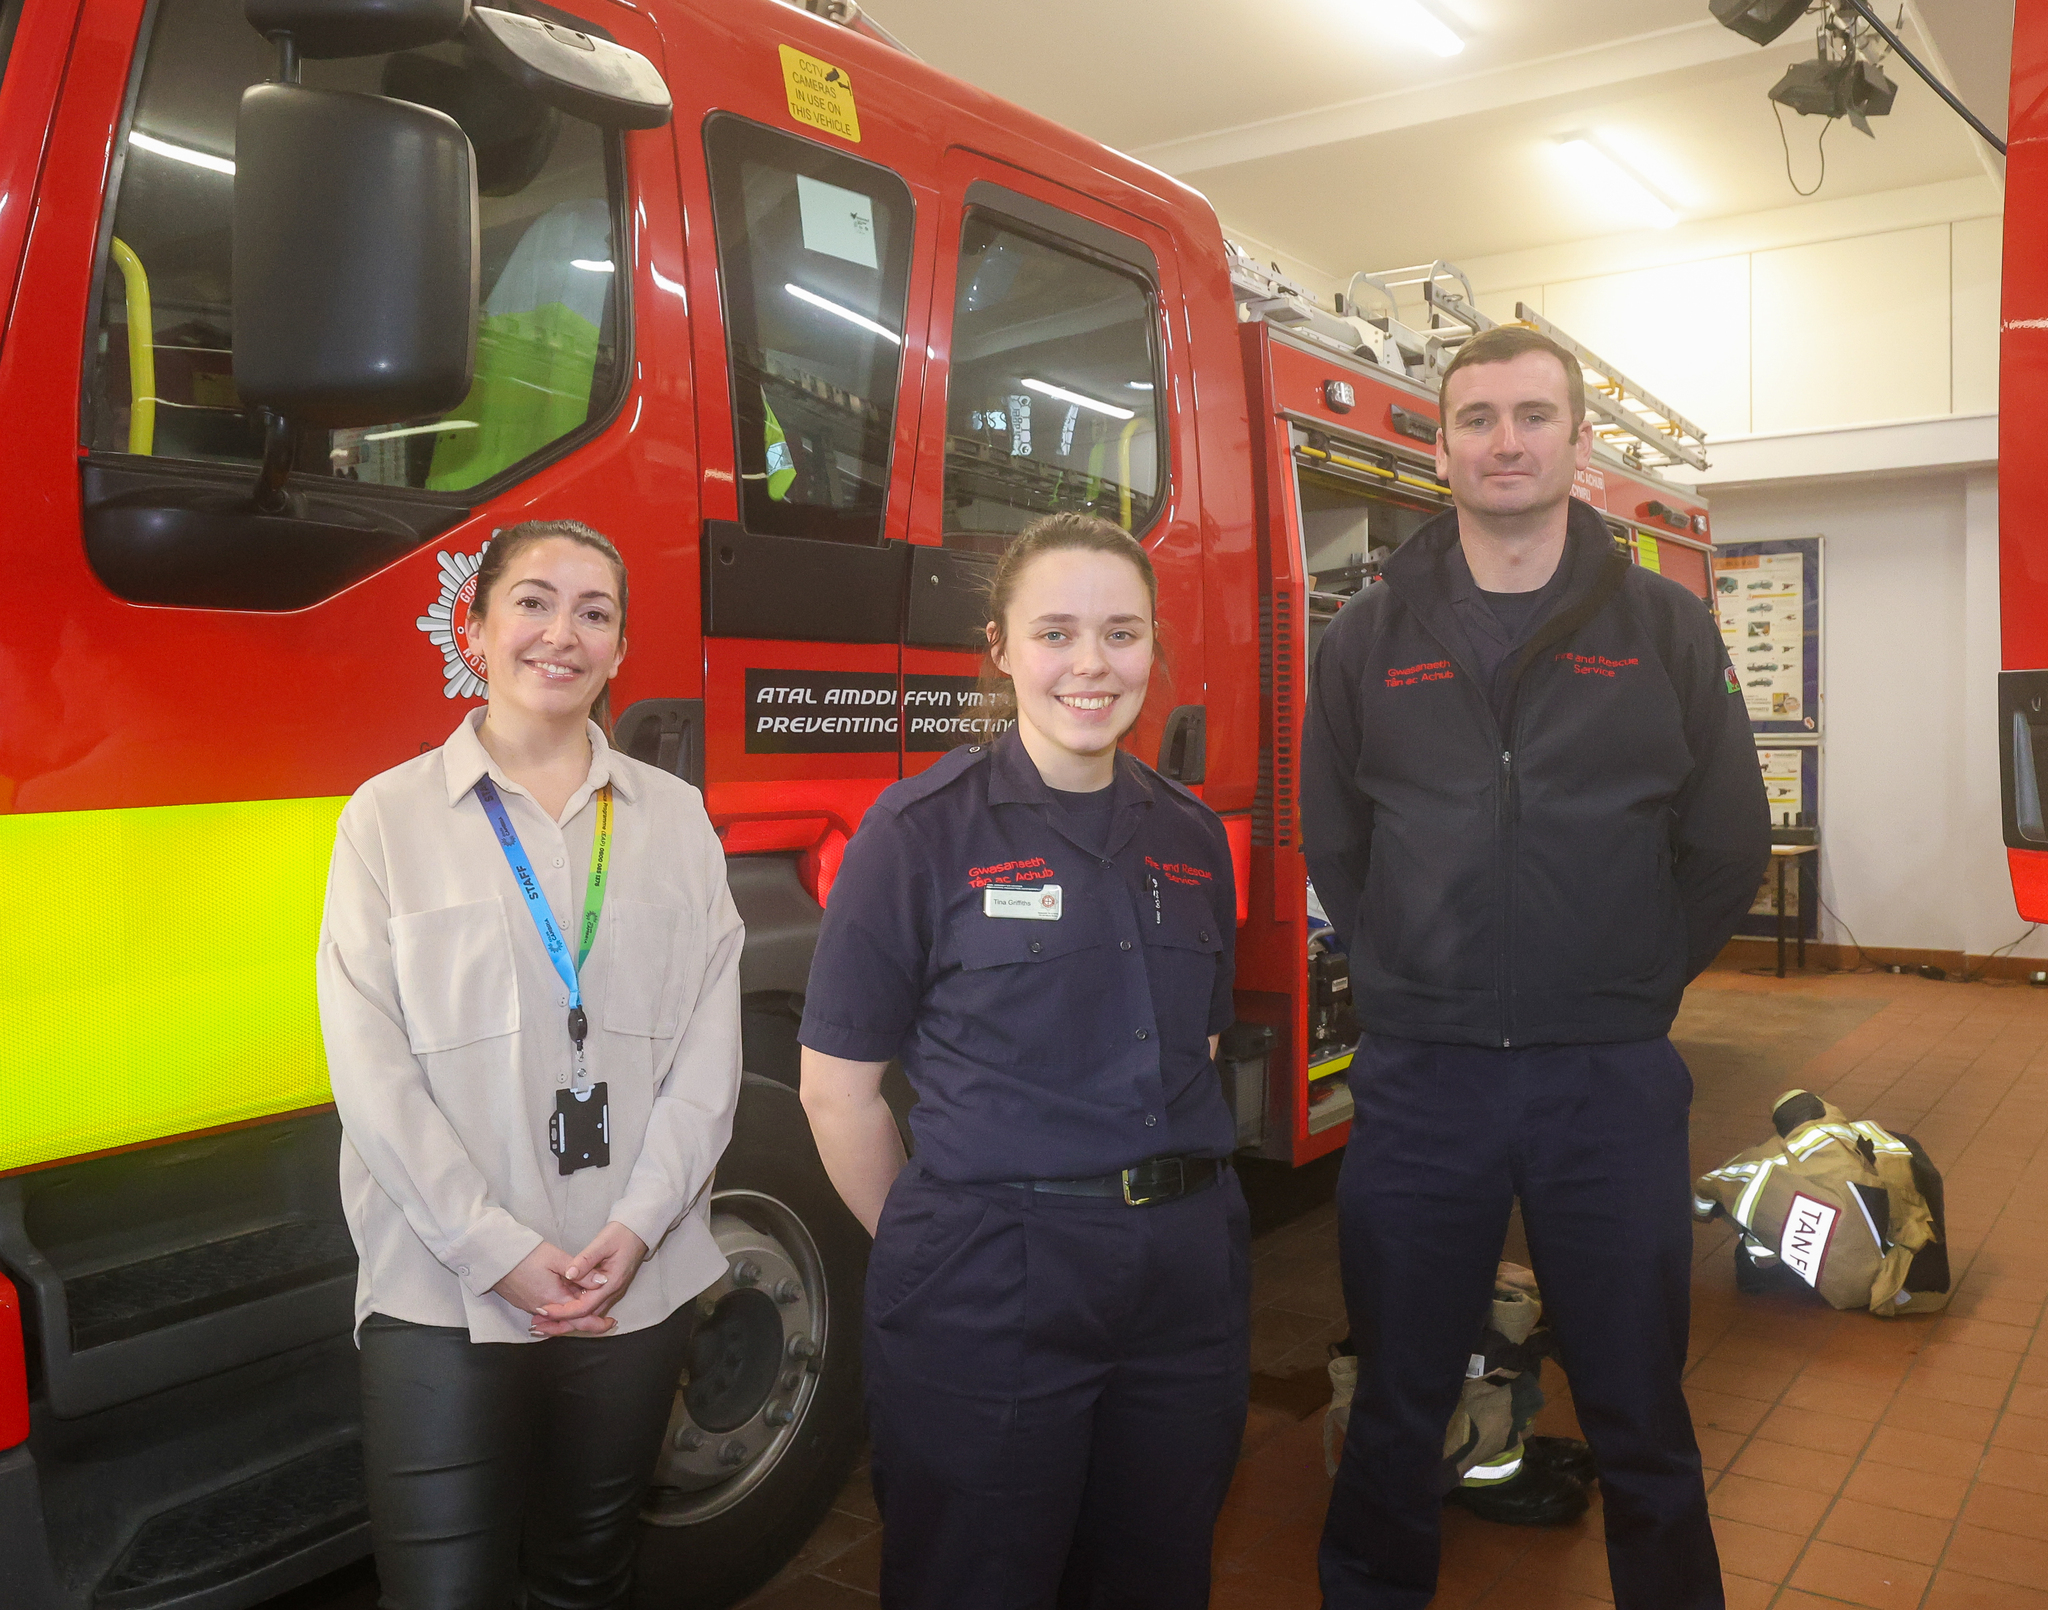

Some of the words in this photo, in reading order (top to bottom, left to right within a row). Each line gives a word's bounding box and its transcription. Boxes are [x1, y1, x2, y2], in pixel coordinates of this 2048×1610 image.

[799, 59, 823, 77] CCTV
[792, 72, 836, 98] CAMERAS
[795, 88, 806, 102] IN
[807, 94, 826, 110] USE
[827, 101, 841, 116] ON
[791, 102, 812, 120] THIS
[813, 111, 852, 136] VEHICLE
[1387, 660, 1451, 677] Gwasanaeth
[1575, 654, 1596, 664] and
[1598, 656, 1639, 667] Rescue
[1421, 671, 1454, 681] Achub
[1574, 664, 1616, 677] Service
[756, 687, 817, 704] ATAL
[756, 716, 899, 733] PREVENTING
[968, 857, 1046, 877] Gwasanaeth
[1015, 867, 1054, 882] Achub
[1162, 863, 1180, 873] and
[516, 865, 539, 900] STAFF
[1008, 899, 1032, 907] Griffiths
